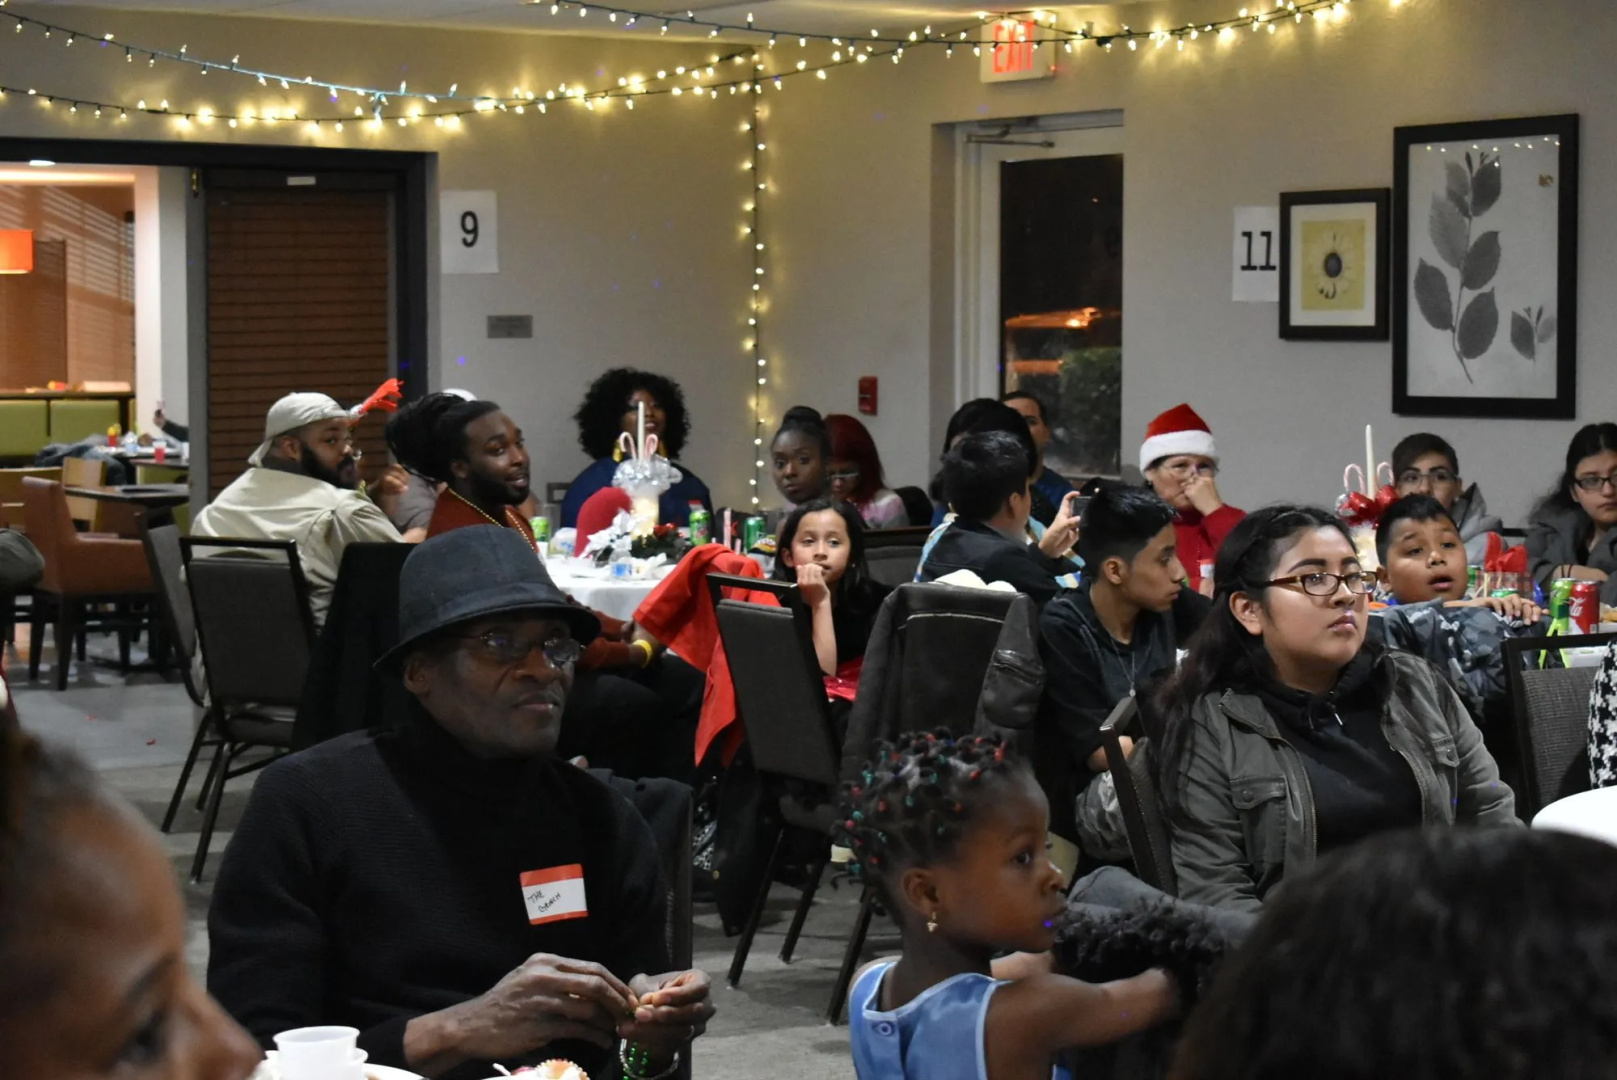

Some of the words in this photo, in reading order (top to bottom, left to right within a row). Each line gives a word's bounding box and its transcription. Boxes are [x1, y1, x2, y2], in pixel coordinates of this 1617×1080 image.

[993, 20, 1035, 74] EXIT
[460, 210, 479, 248] 9
[1240, 231, 1277, 271] 11
[527, 890, 545, 904] THE
